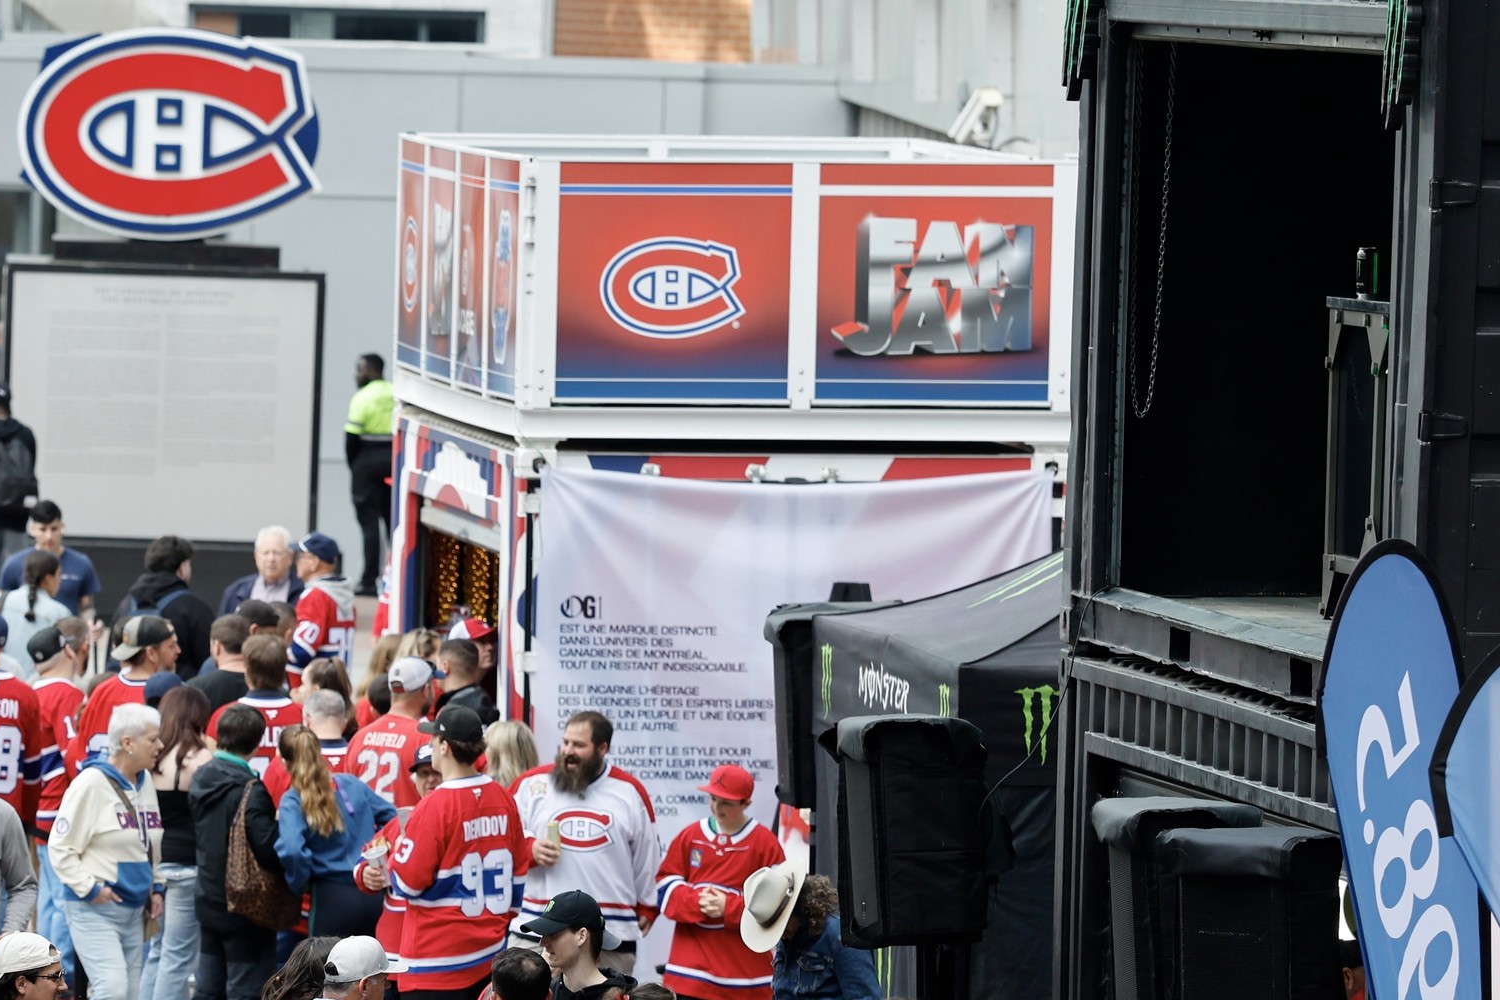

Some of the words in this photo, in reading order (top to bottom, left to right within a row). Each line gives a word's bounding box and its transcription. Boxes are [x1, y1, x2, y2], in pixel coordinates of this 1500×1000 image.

[855, 213, 1034, 289] FAN
[830, 285, 1034, 357] JAM
[560, 623, 581, 634] EST
[583, 624, 607, 635] UNE
[609, 625, 658, 636] MARQUE
[661, 626, 717, 637] DISTINCTE
[559, 636, 590, 647] DANS
[593, 637, 648, 648] L'UNIVERS
[651, 638, 673, 648] DES
[559, 648, 623, 659] CANADIENS
[625, 649, 641, 659] DE
[560, 660, 588, 670] TOUT
[591, 661, 607, 671] EN
[609, 661, 660, 672] RESTANT
[662, 662, 749, 673] INDISSOCIABLE.
[558, 684, 585, 695] ELLE
[586, 685, 637, 696] INCARNE
[858, 662, 911, 714] MONSTER
[558, 696, 581, 706] DES
[583, 695, 641, 708] LÉGENDES
[643, 697, 658, 708] ET
[660, 698, 684, 708] DES
[686, 698, 733, 709] ESPRITS
[617, 710, 635, 720] UN
[637, 710, 680, 721] PEUPLE
[683, 711, 696, 721] ET
[699, 711, 724, 722] UNE
[726, 709, 767, 722] ÉQUIPE
[641, 723, 681, 732] AUTRE.
[363, 731, 407, 750] CAUFIELD
[618, 746, 646, 756] L'ART
[649, 746, 663, 756] ET
[665, 746, 679, 756] LE
[682, 747, 718, 757] STYLE
[719, 747, 752, 758] POUR
[613, 758, 664, 769] TRACENT
[666, 759, 697, 769] LEUR
[639, 770, 683, 781] COMME
[462, 814, 509, 843] DEMIDOV
[461, 848, 514, 918] 93
